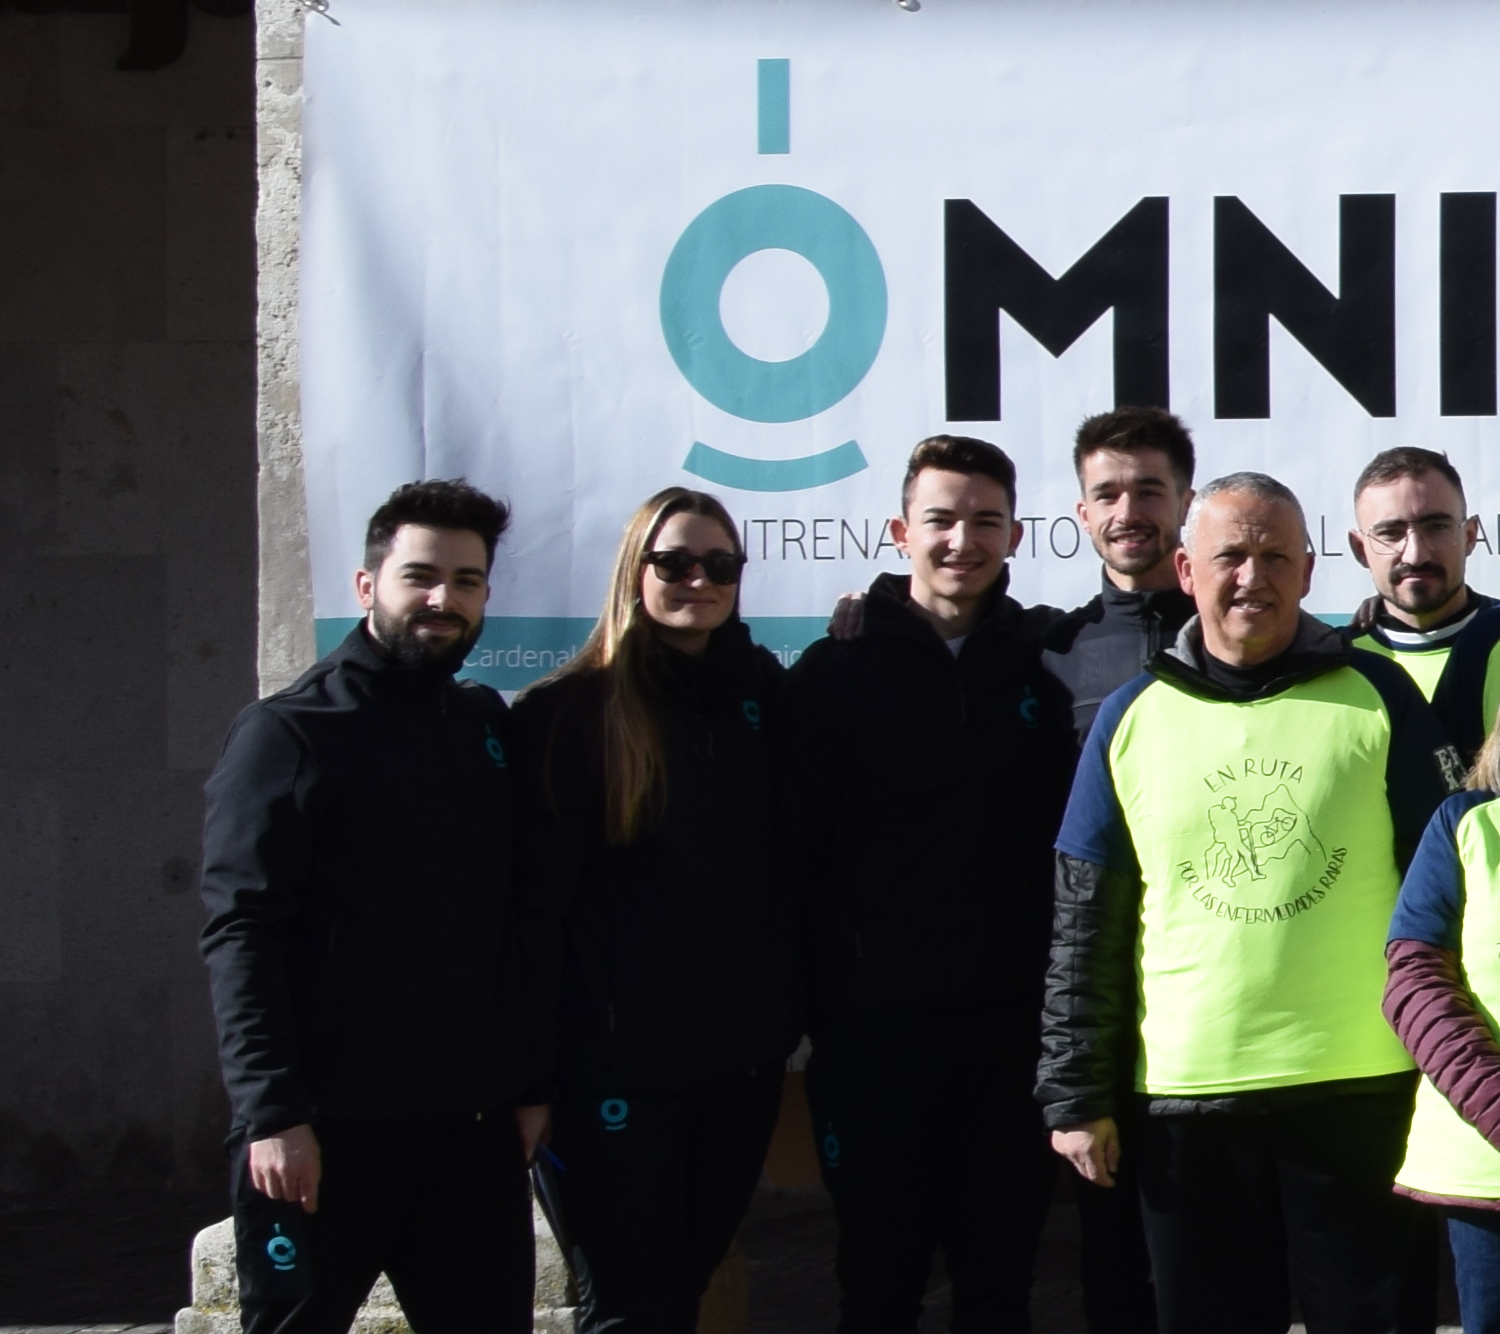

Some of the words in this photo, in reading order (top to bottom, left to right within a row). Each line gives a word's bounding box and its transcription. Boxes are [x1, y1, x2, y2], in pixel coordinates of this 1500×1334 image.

[1204, 764, 1236, 793] EN
[1245, 758, 1304, 785] RUTA
[1177, 860, 1195, 888] POR
[1193, 886, 1217, 911] LAS
[1216, 886, 1325, 924] ENFERMEDADES
[1323, 845, 1348, 890] RARAS
